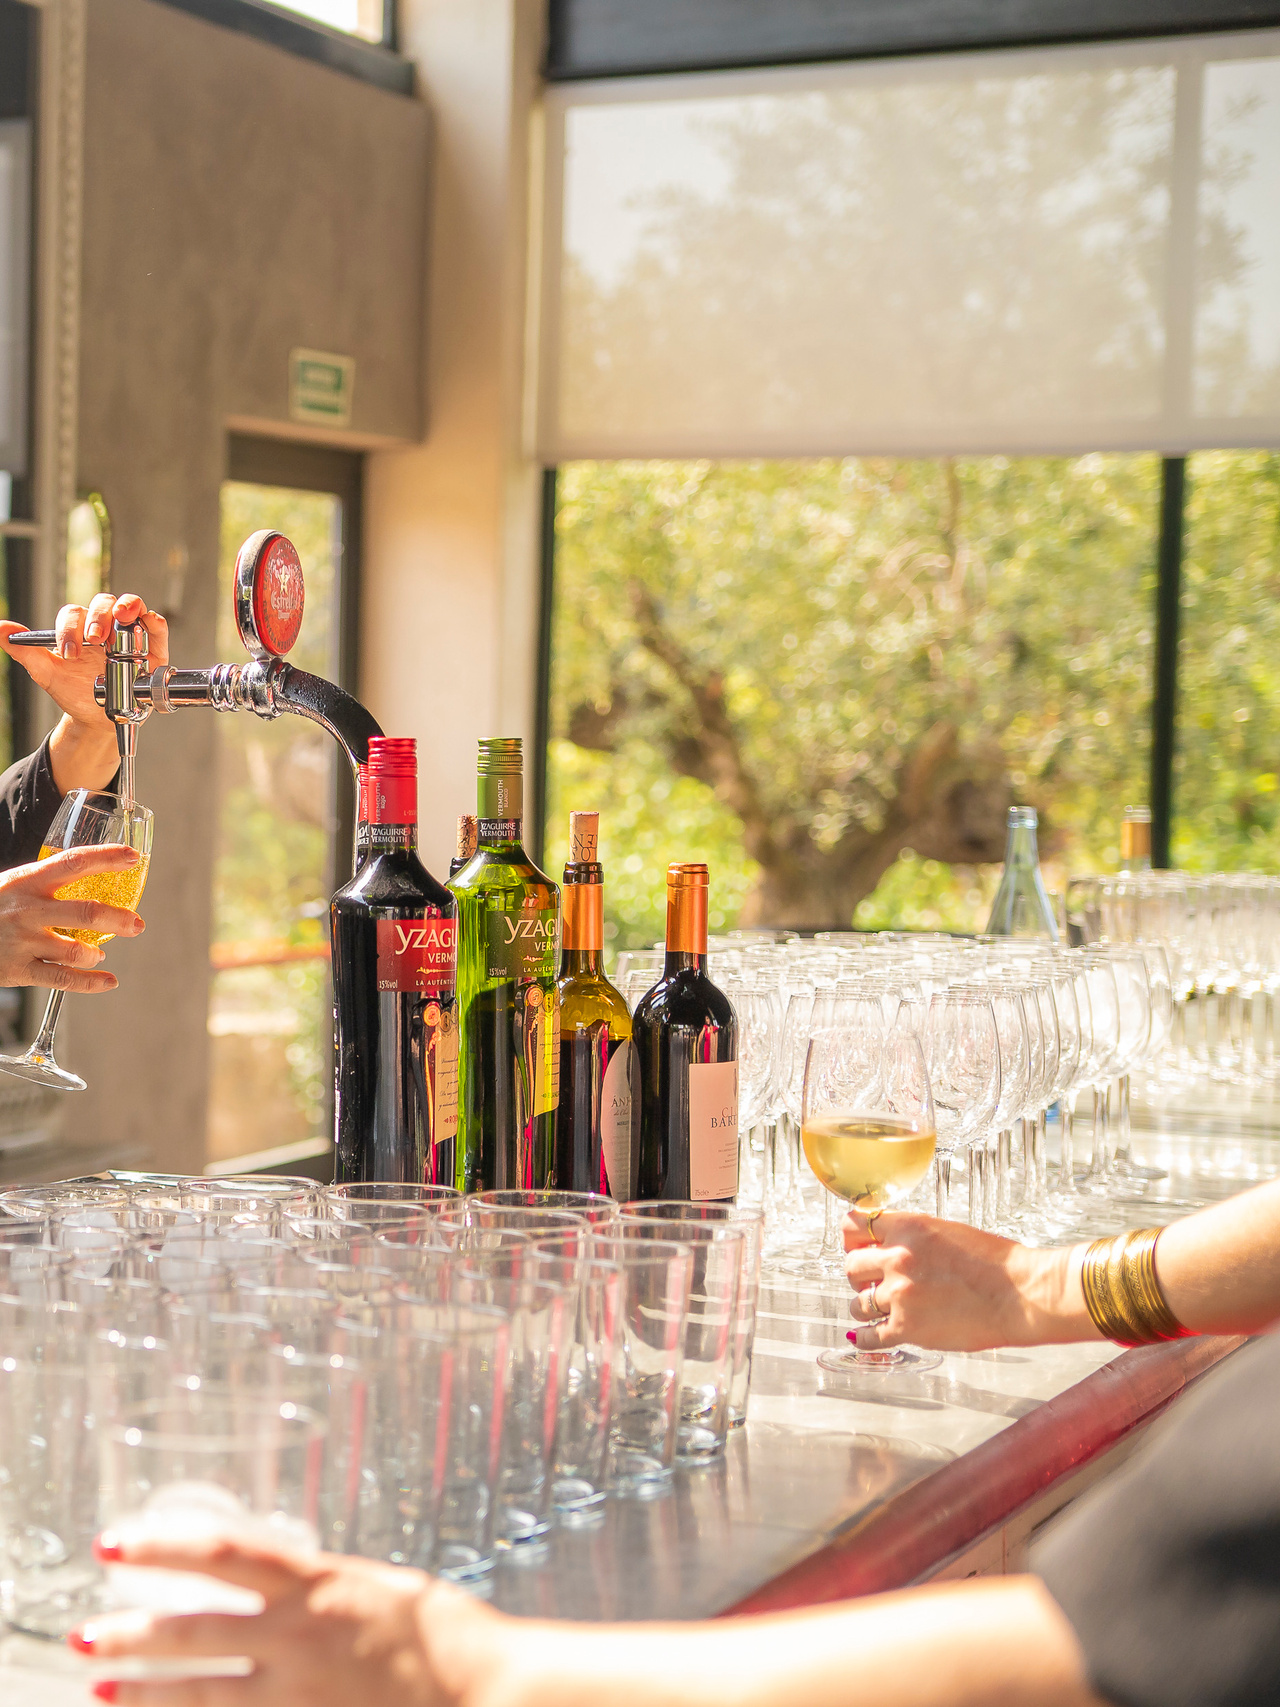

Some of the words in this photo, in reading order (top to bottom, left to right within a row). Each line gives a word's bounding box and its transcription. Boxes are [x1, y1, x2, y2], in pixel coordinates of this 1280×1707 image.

[480, 822, 516, 831] YZAGUIRRE
[371, 826, 409, 836] YZAGUIRRE
[480, 829, 516, 837] VERMOUTH
[371, 835, 410, 843] VERMOUTH
